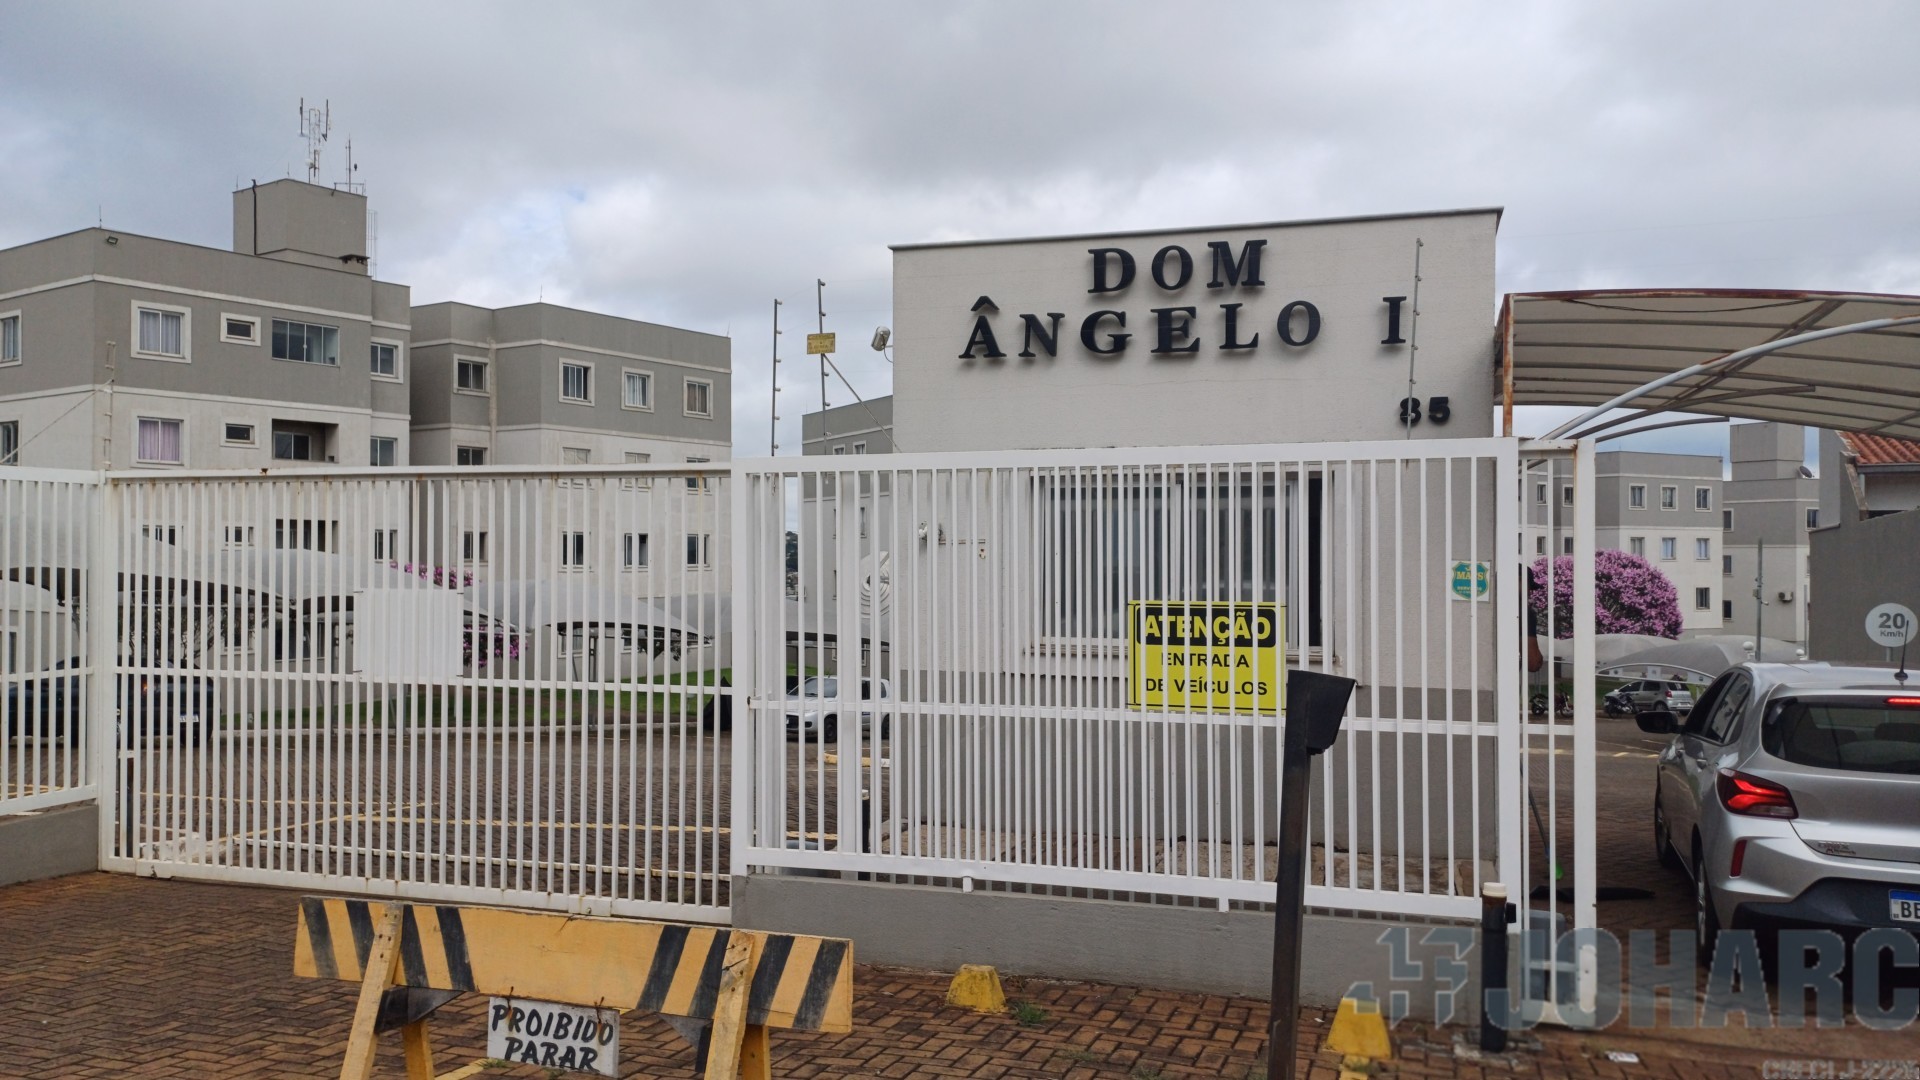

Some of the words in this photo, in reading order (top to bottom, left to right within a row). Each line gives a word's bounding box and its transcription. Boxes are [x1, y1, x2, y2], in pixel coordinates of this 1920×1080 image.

[1088, 239, 1268, 294] DOM
[958, 295, 1322, 359] ÂNGELO
[1380, 296, 1407, 345] I
[1399, 396, 1451, 427] 85
[1456, 571, 1484, 581] MAS
[1144, 611, 1272, 645] ATENÇÃO
[1878, 612, 1906, 629] 20
[1880, 630, 1904, 638] Km/h
[1160, 652, 1250, 668] ENTRADA
[1146, 678, 1165, 692] DE
[491, 1004, 614, 1046] PROIBIDO
[504, 1036, 600, 1074] PARAR
